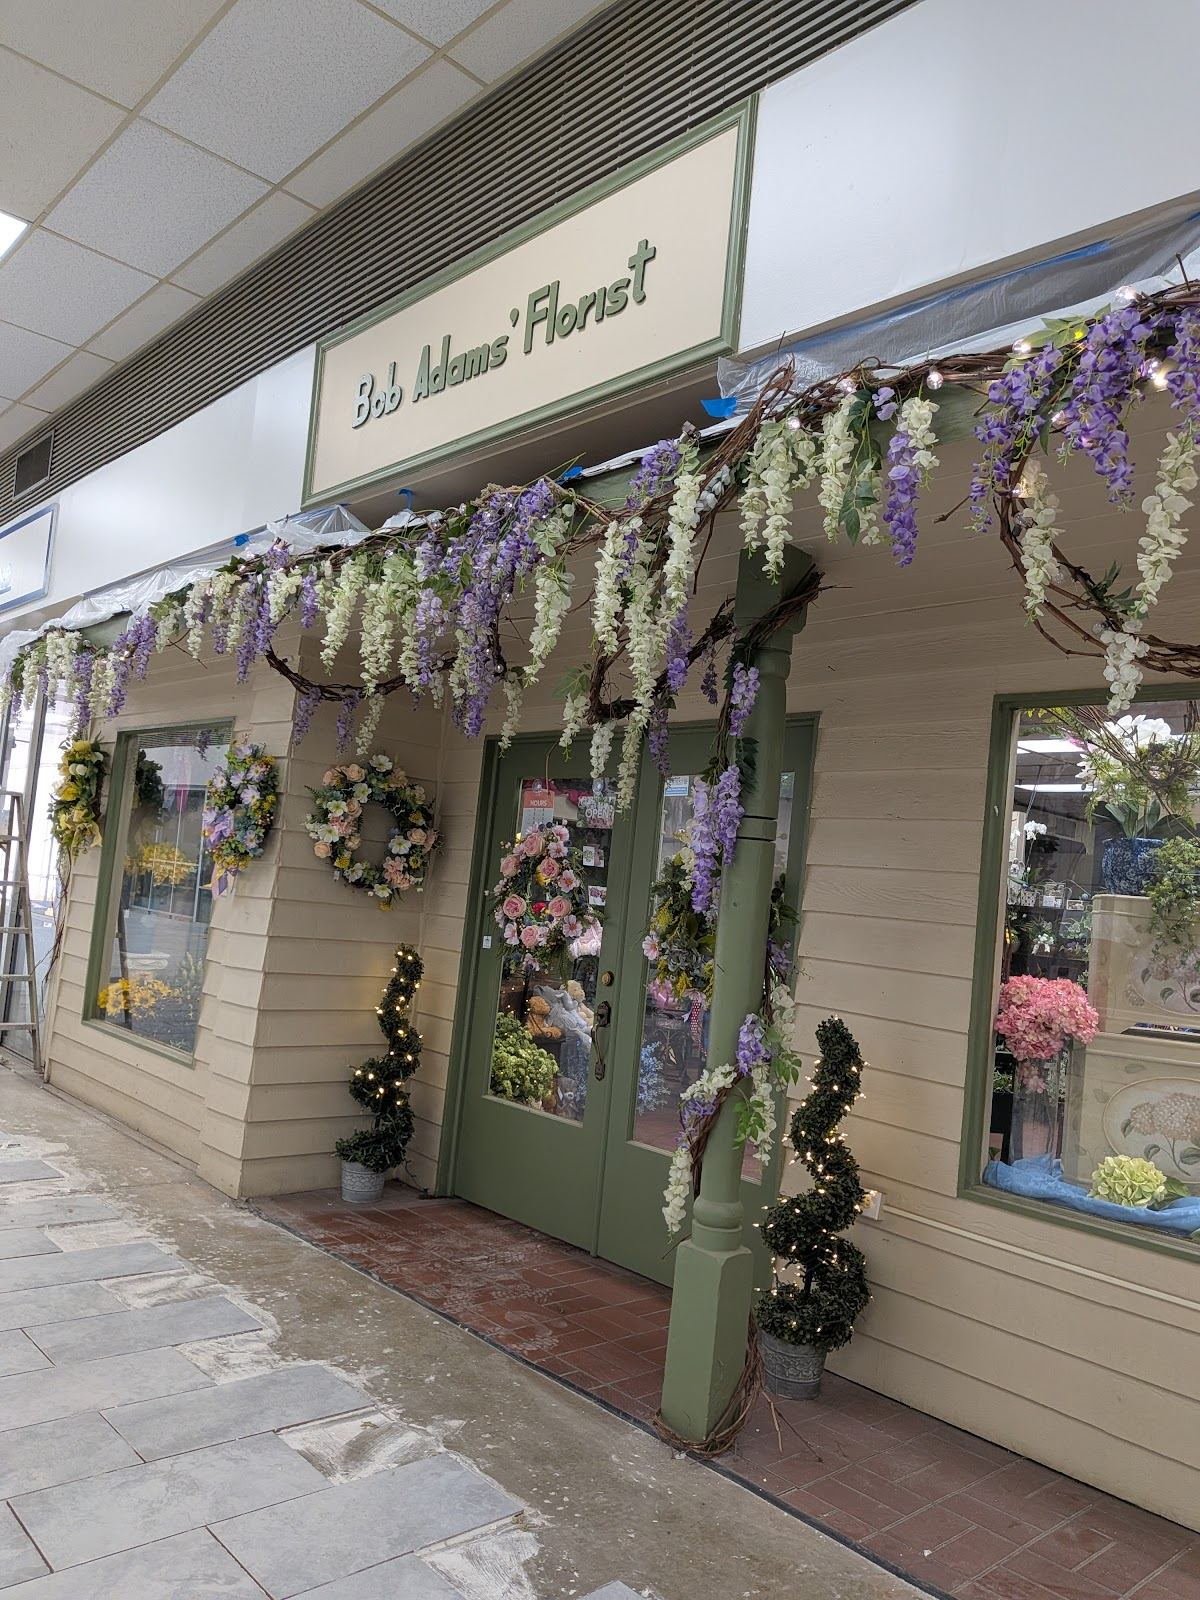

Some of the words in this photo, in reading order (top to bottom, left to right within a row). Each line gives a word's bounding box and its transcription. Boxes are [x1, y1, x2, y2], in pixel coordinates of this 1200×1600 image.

[351, 361, 403, 429] Bob
[412, 307, 519, 402] Adams'
[523, 238, 657, 354] Florist
[585, 808, 609, 819] OPEN
